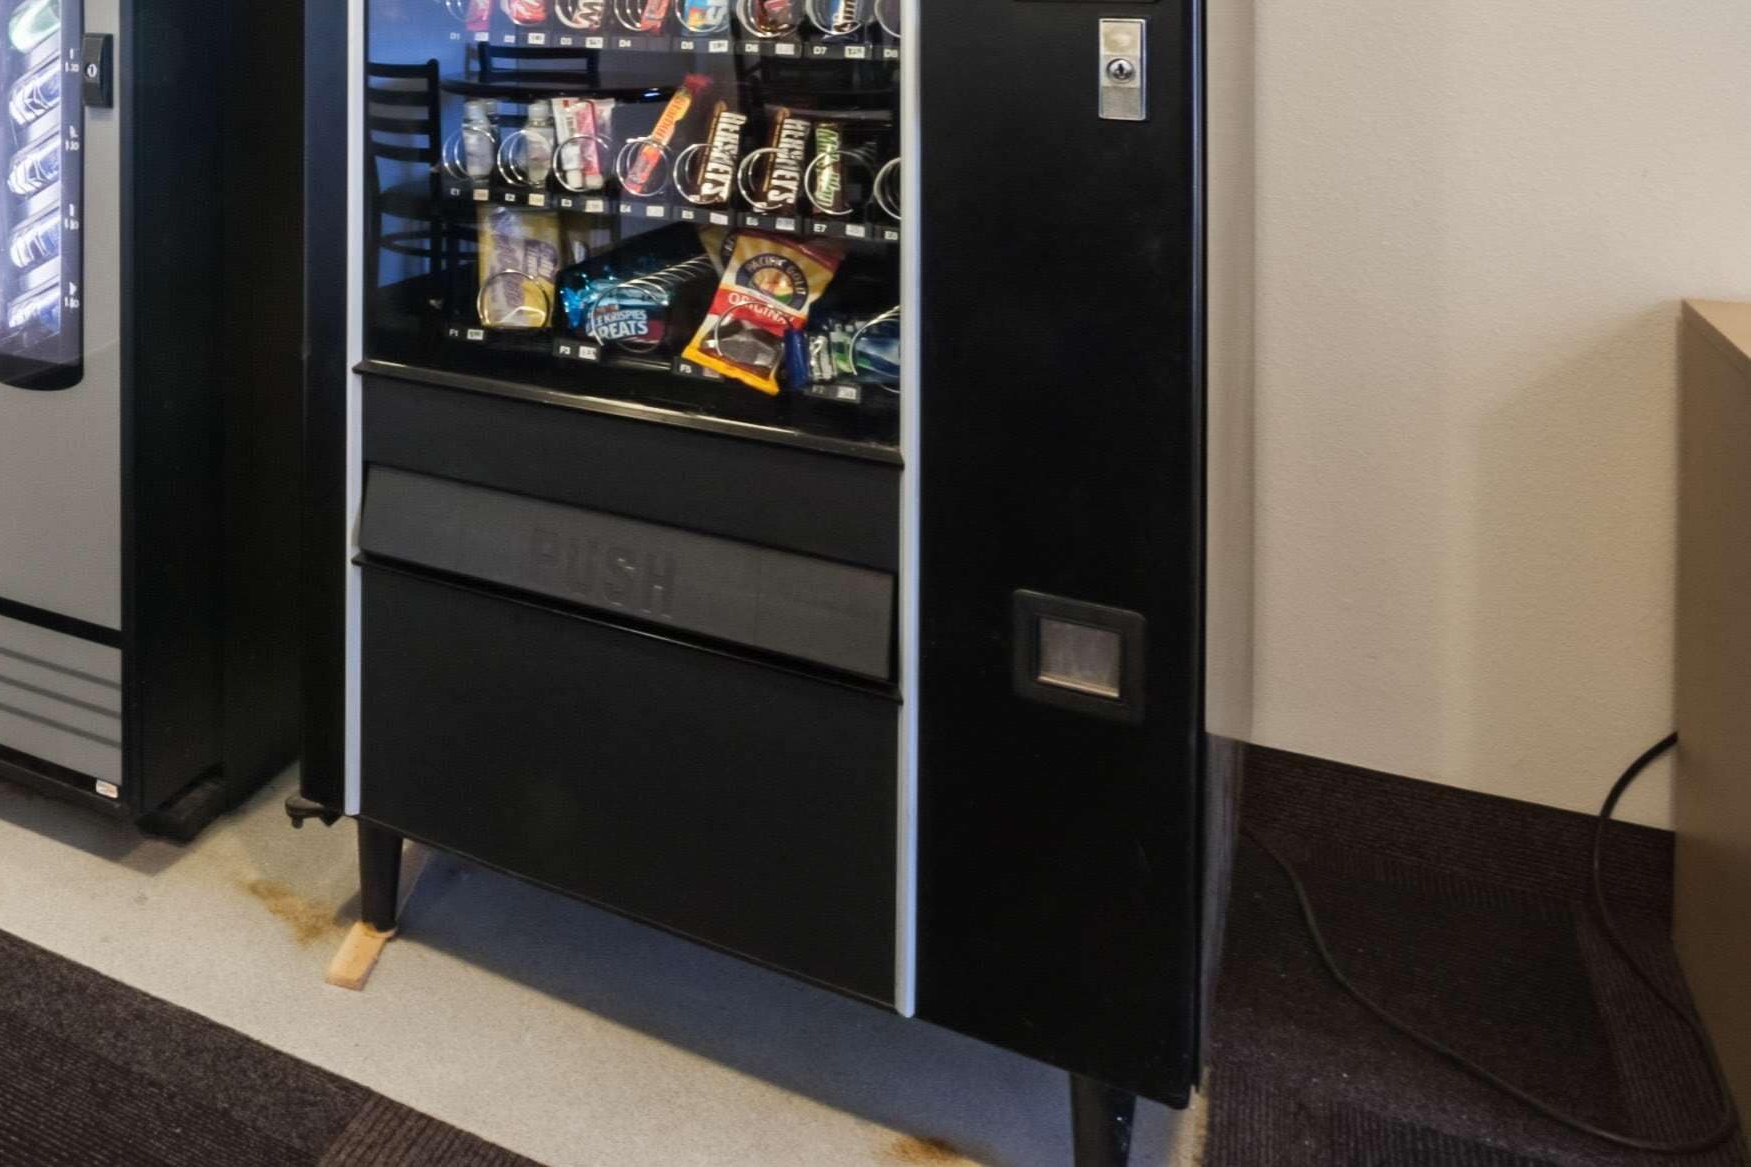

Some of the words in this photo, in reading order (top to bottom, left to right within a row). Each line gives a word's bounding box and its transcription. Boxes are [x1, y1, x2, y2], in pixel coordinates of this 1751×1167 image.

[813, 47, 827, 55] D7
[814, 223, 827, 232] E7
[603, 309, 648, 327] KRISPIES
[530, 524, 676, 614] PUSH
